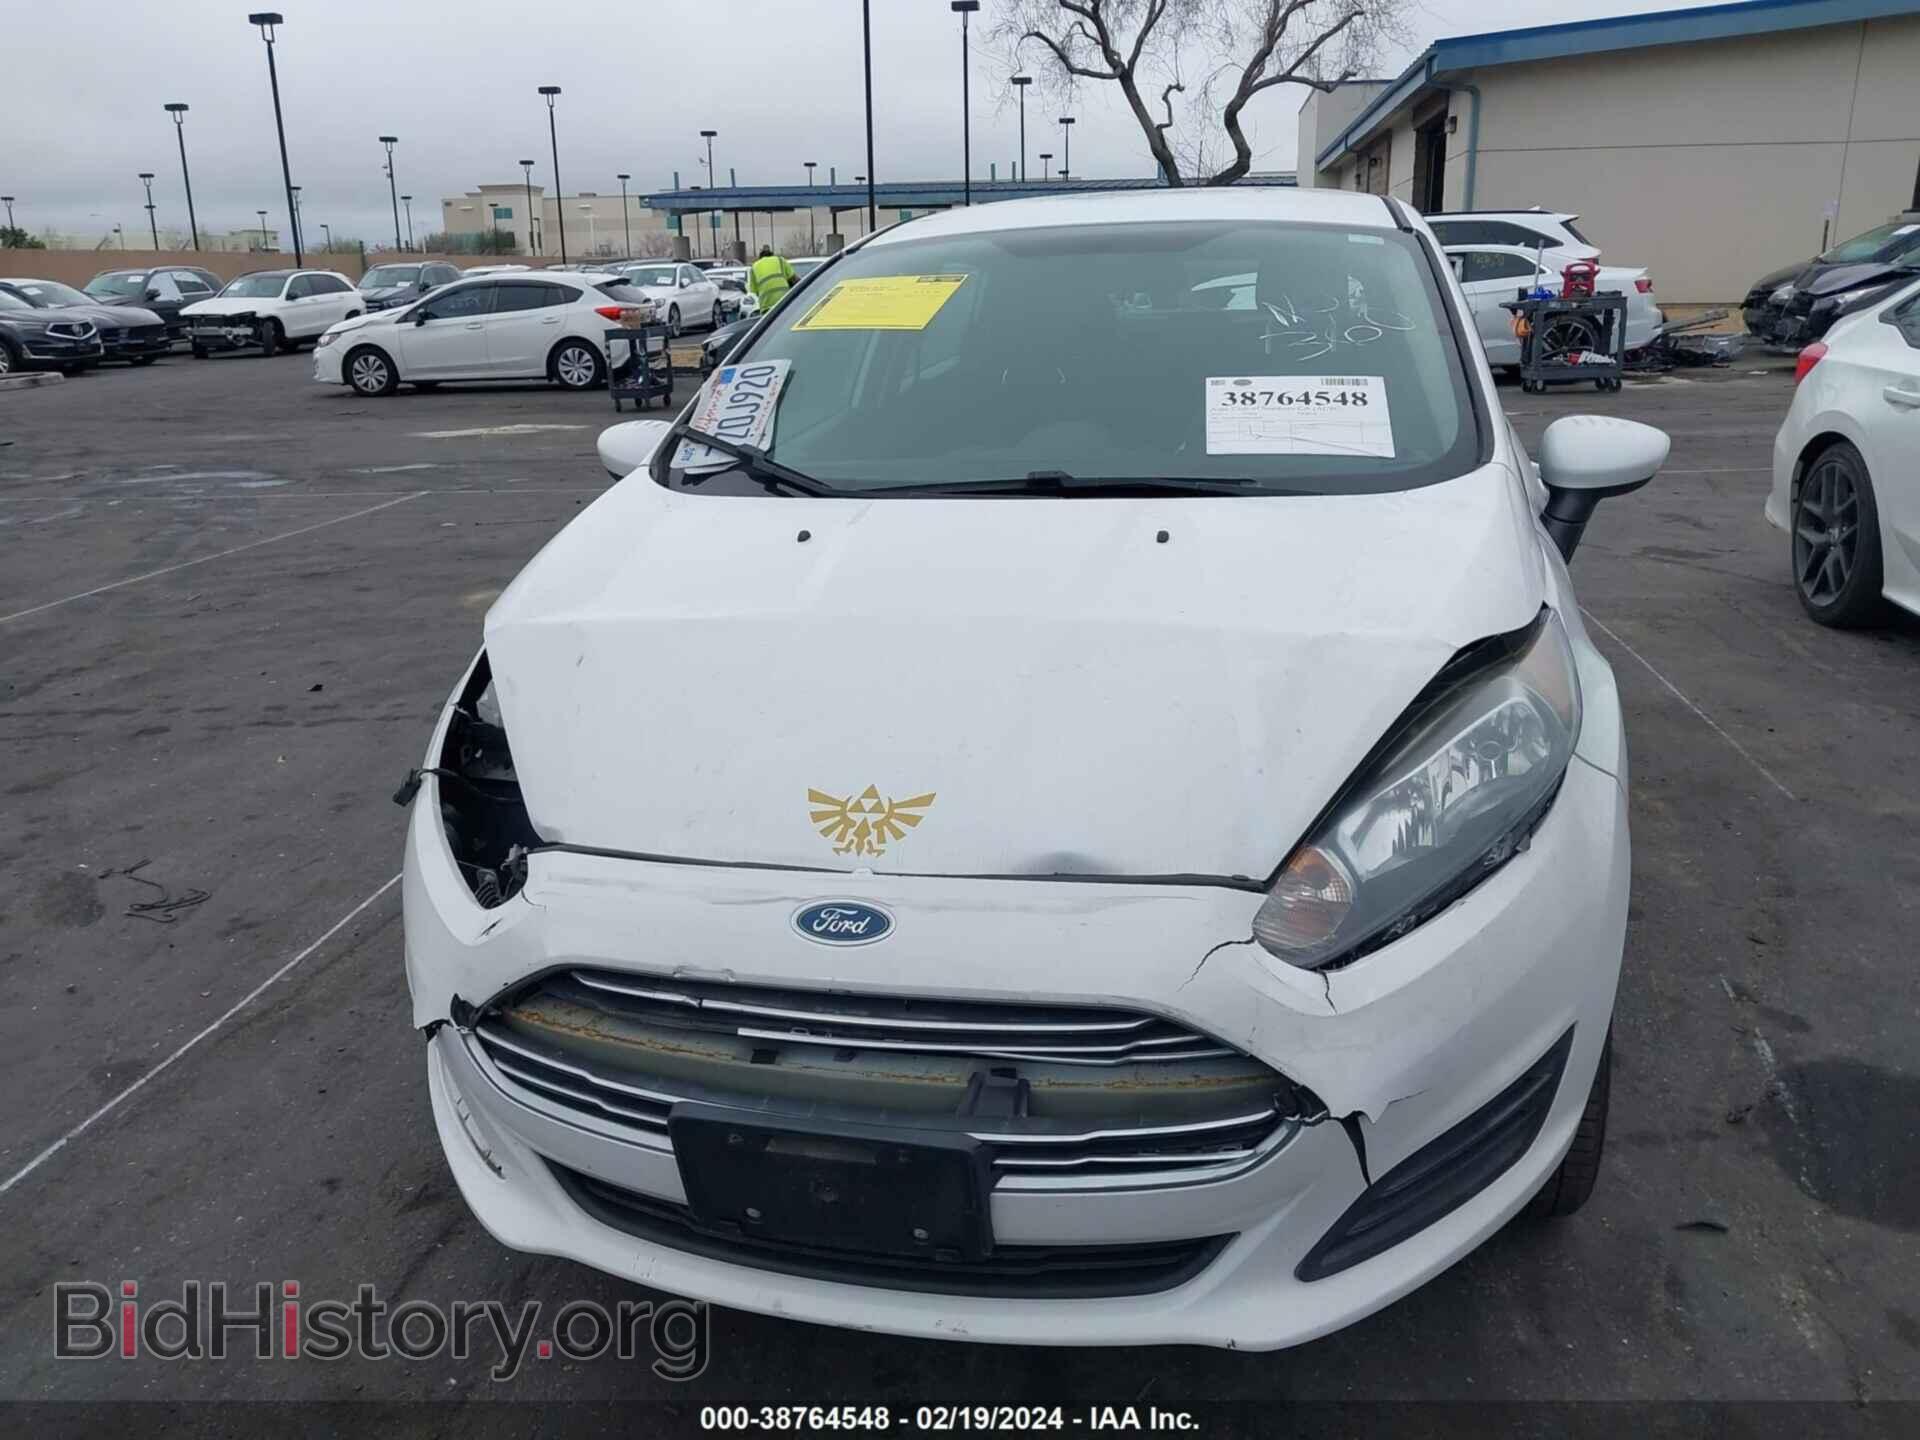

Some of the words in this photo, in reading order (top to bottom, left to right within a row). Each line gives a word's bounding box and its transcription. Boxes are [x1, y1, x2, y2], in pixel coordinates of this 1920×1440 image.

[704, 365, 777, 457] ZOJ920
[1221, 391, 1369, 407] 38764548
[812, 907, 872, 934] Ford
